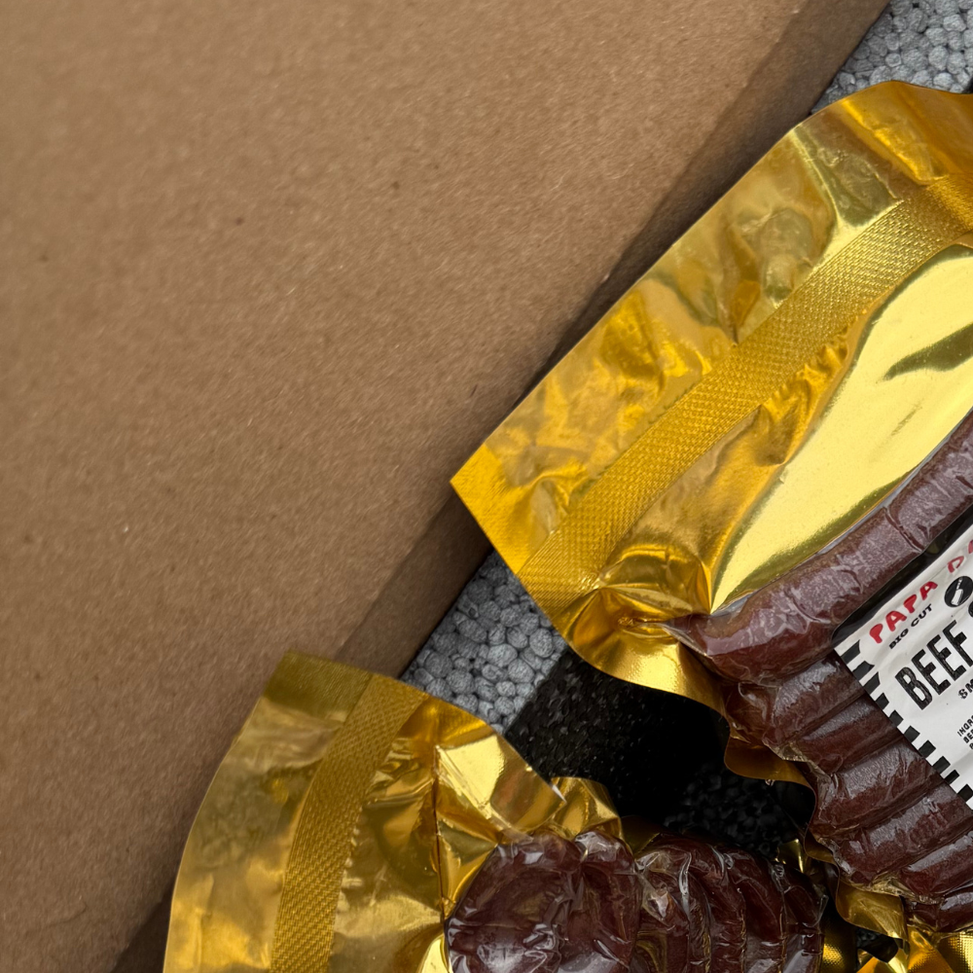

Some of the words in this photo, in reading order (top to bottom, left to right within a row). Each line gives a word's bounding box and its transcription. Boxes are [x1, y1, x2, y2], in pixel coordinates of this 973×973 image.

[869, 580, 938, 644] PAPA
[889, 628, 909, 649] BIG
[910, 603, 932, 627] CUT
